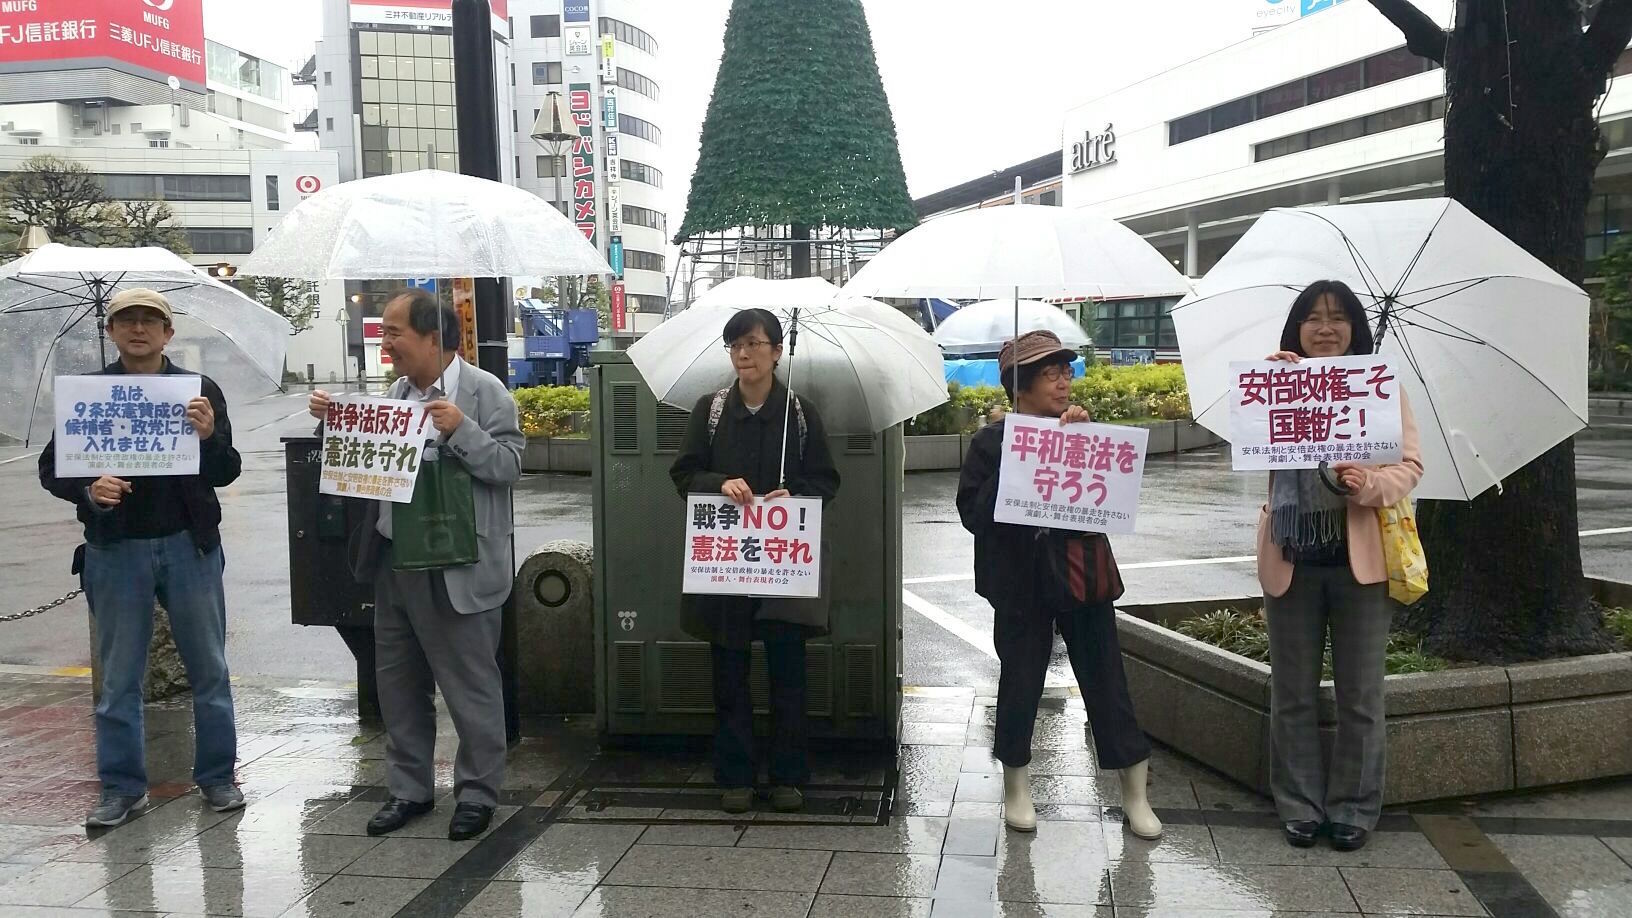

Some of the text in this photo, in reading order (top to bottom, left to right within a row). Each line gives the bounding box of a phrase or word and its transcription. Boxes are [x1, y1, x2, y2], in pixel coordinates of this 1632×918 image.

[2, 1, 37, 13] MUFG
[1256, 5, 1296, 18] eyecity
[143, 11, 170, 30] MUFG
[109, 22, 202, 65] 三菱UFJ信託銀行
[1071, 123, 1116, 172] atré
[570, 90, 597, 241] ヨドバシカメラ
[1239, 363, 1395, 406] 安倍政権こそ
[74, 401, 187, 419] 9条改憲賛成の
[326, 401, 431, 437] 戦争法反対！
[65, 419, 195, 436] 候補者・政党には
[83, 436, 178, 452] 入れません！
[1011, 425, 1138, 474] 平和憲法を
[1242, 441, 1398, 456] 安保法制と安倍政権の暴走を許さない
[324, 435, 418, 473] 憲法を守れ
[1268, 451, 1371, 464] 演劇人・舞台表現者の会
[1033, 466, 1108, 507] 守ろう
[1005, 498, 1130, 520] 安保法制と安倍政権の暴走を許さない
[1025, 509, 1107, 526] 演劇人・舞台表現者の会
[691, 534, 813, 564] 憲法を守れ
[691, 566, 811, 576] 安保法制と安倍政権の暴走を許さない
[711, 576, 789, 585] 演劇人・舞台表現者の会
